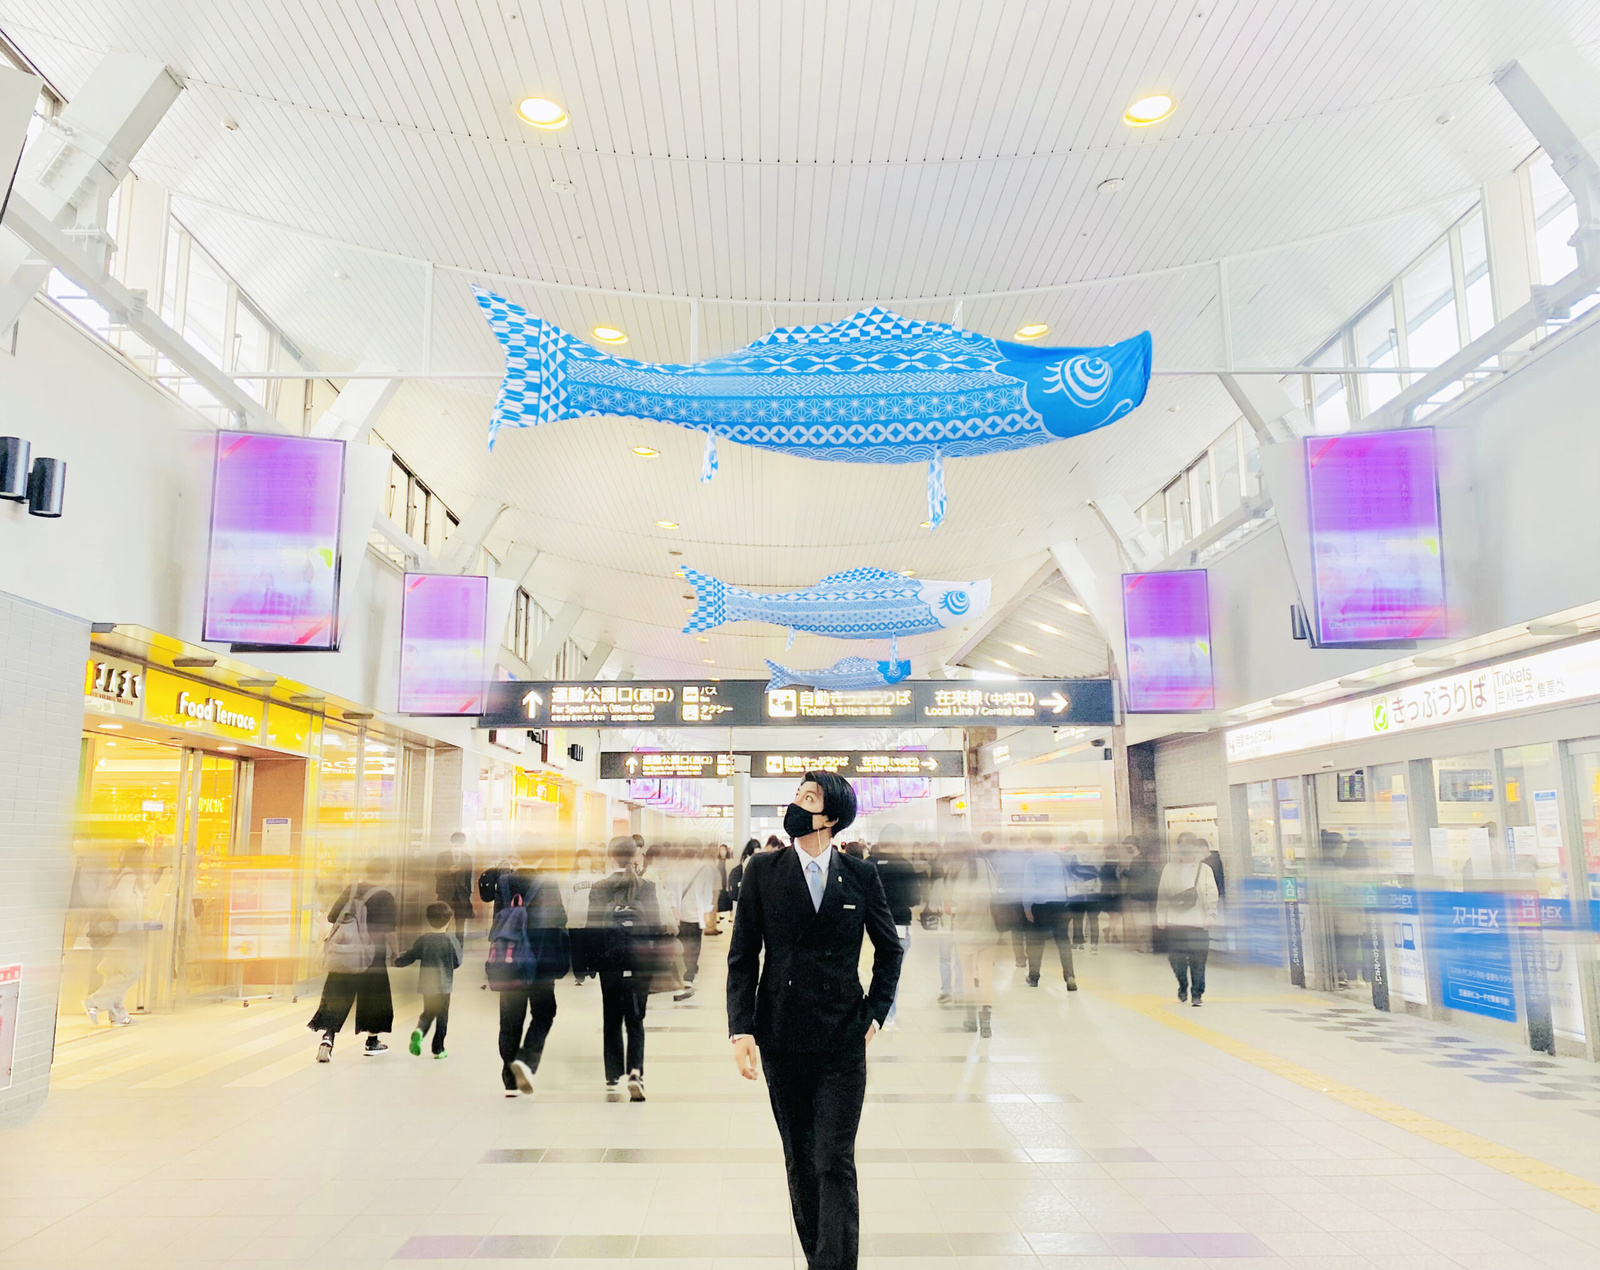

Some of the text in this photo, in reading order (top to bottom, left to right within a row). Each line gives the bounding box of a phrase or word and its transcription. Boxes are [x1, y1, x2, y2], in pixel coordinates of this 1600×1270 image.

[1494, 666, 1533, 687] Tickets
[700, 686, 718, 696] バス
[934, 689, 1036, 707] 在来線(中央口)
[1392, 675, 1487, 724] きっぷうりば
[178, 691, 255, 731] Food Terrace
[551, 703, 655, 714] For Sports Park (West Gate)
[799, 706, 834, 716] Tickets
[925, 706, 950, 717] Local
[952, 706, 973, 717] Line
[981, 706, 1011, 717] Central
[1013, 706, 1035, 717] Gate
[1521, 894, 1537, 919] 出口
